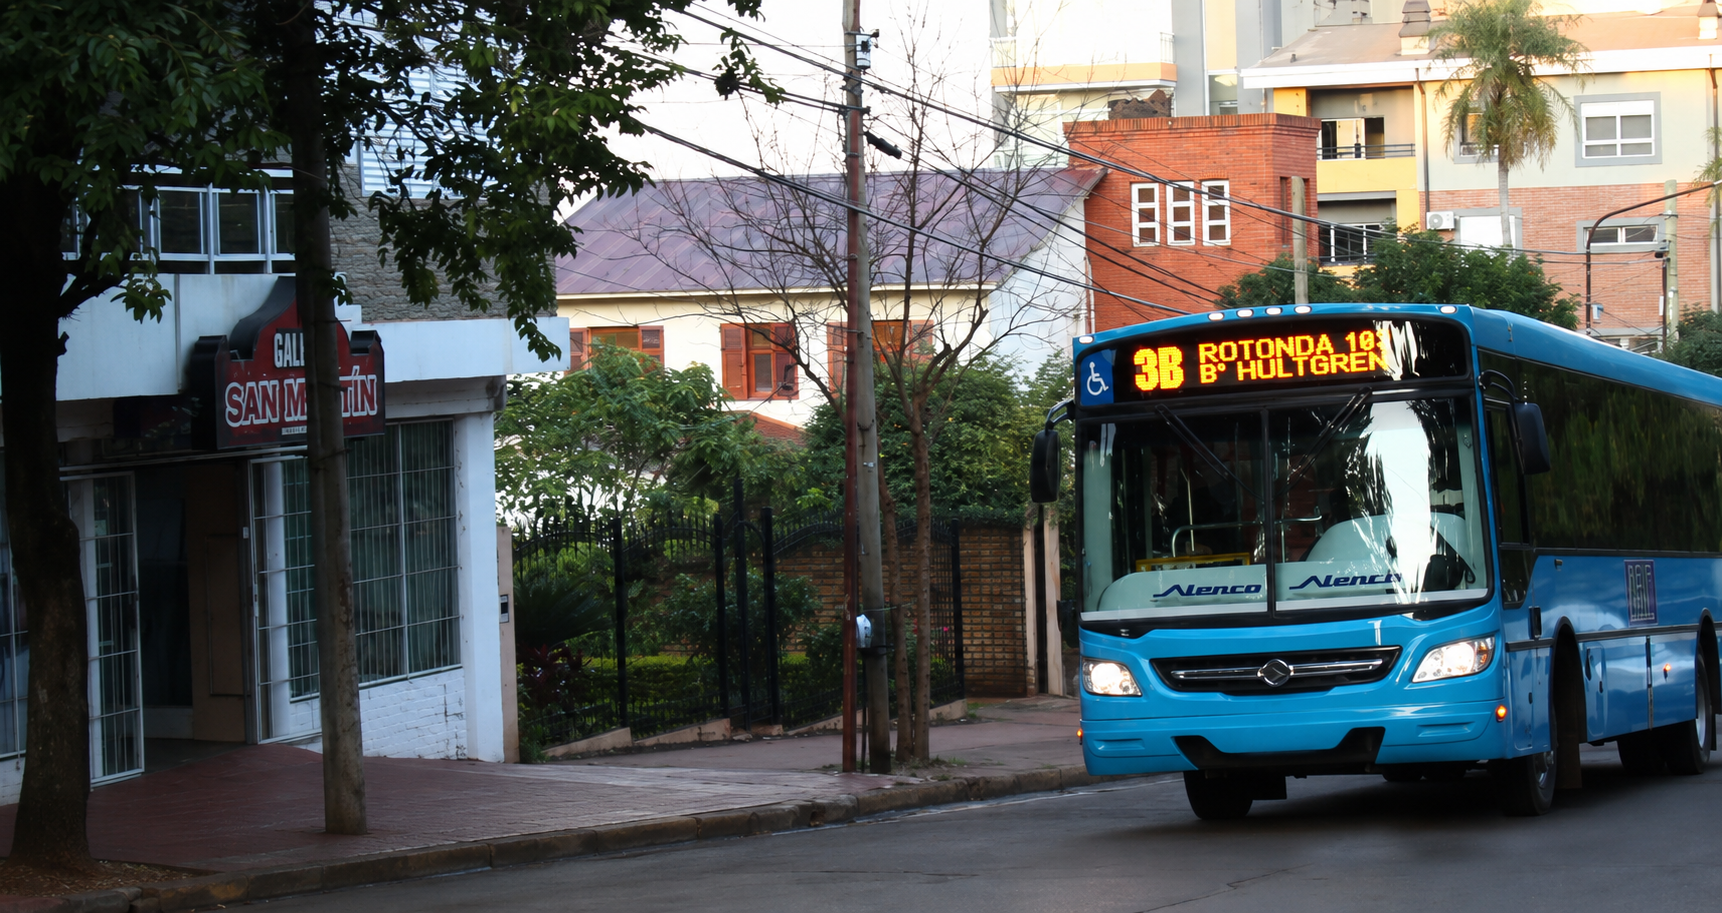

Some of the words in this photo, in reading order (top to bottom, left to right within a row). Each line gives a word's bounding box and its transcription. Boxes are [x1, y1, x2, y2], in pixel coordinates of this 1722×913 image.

[1199, 334, 1334, 363] ROTONDA
[1134, 346, 1184, 390] 3B
[1237, 349, 1389, 380] HULTGREN
[224, 379, 280, 428] SAN
[284, 365, 378, 423] MTÍN
[1153, 584, 1262, 598] Alenco
[1288, 573, 1402, 590] Alenco
